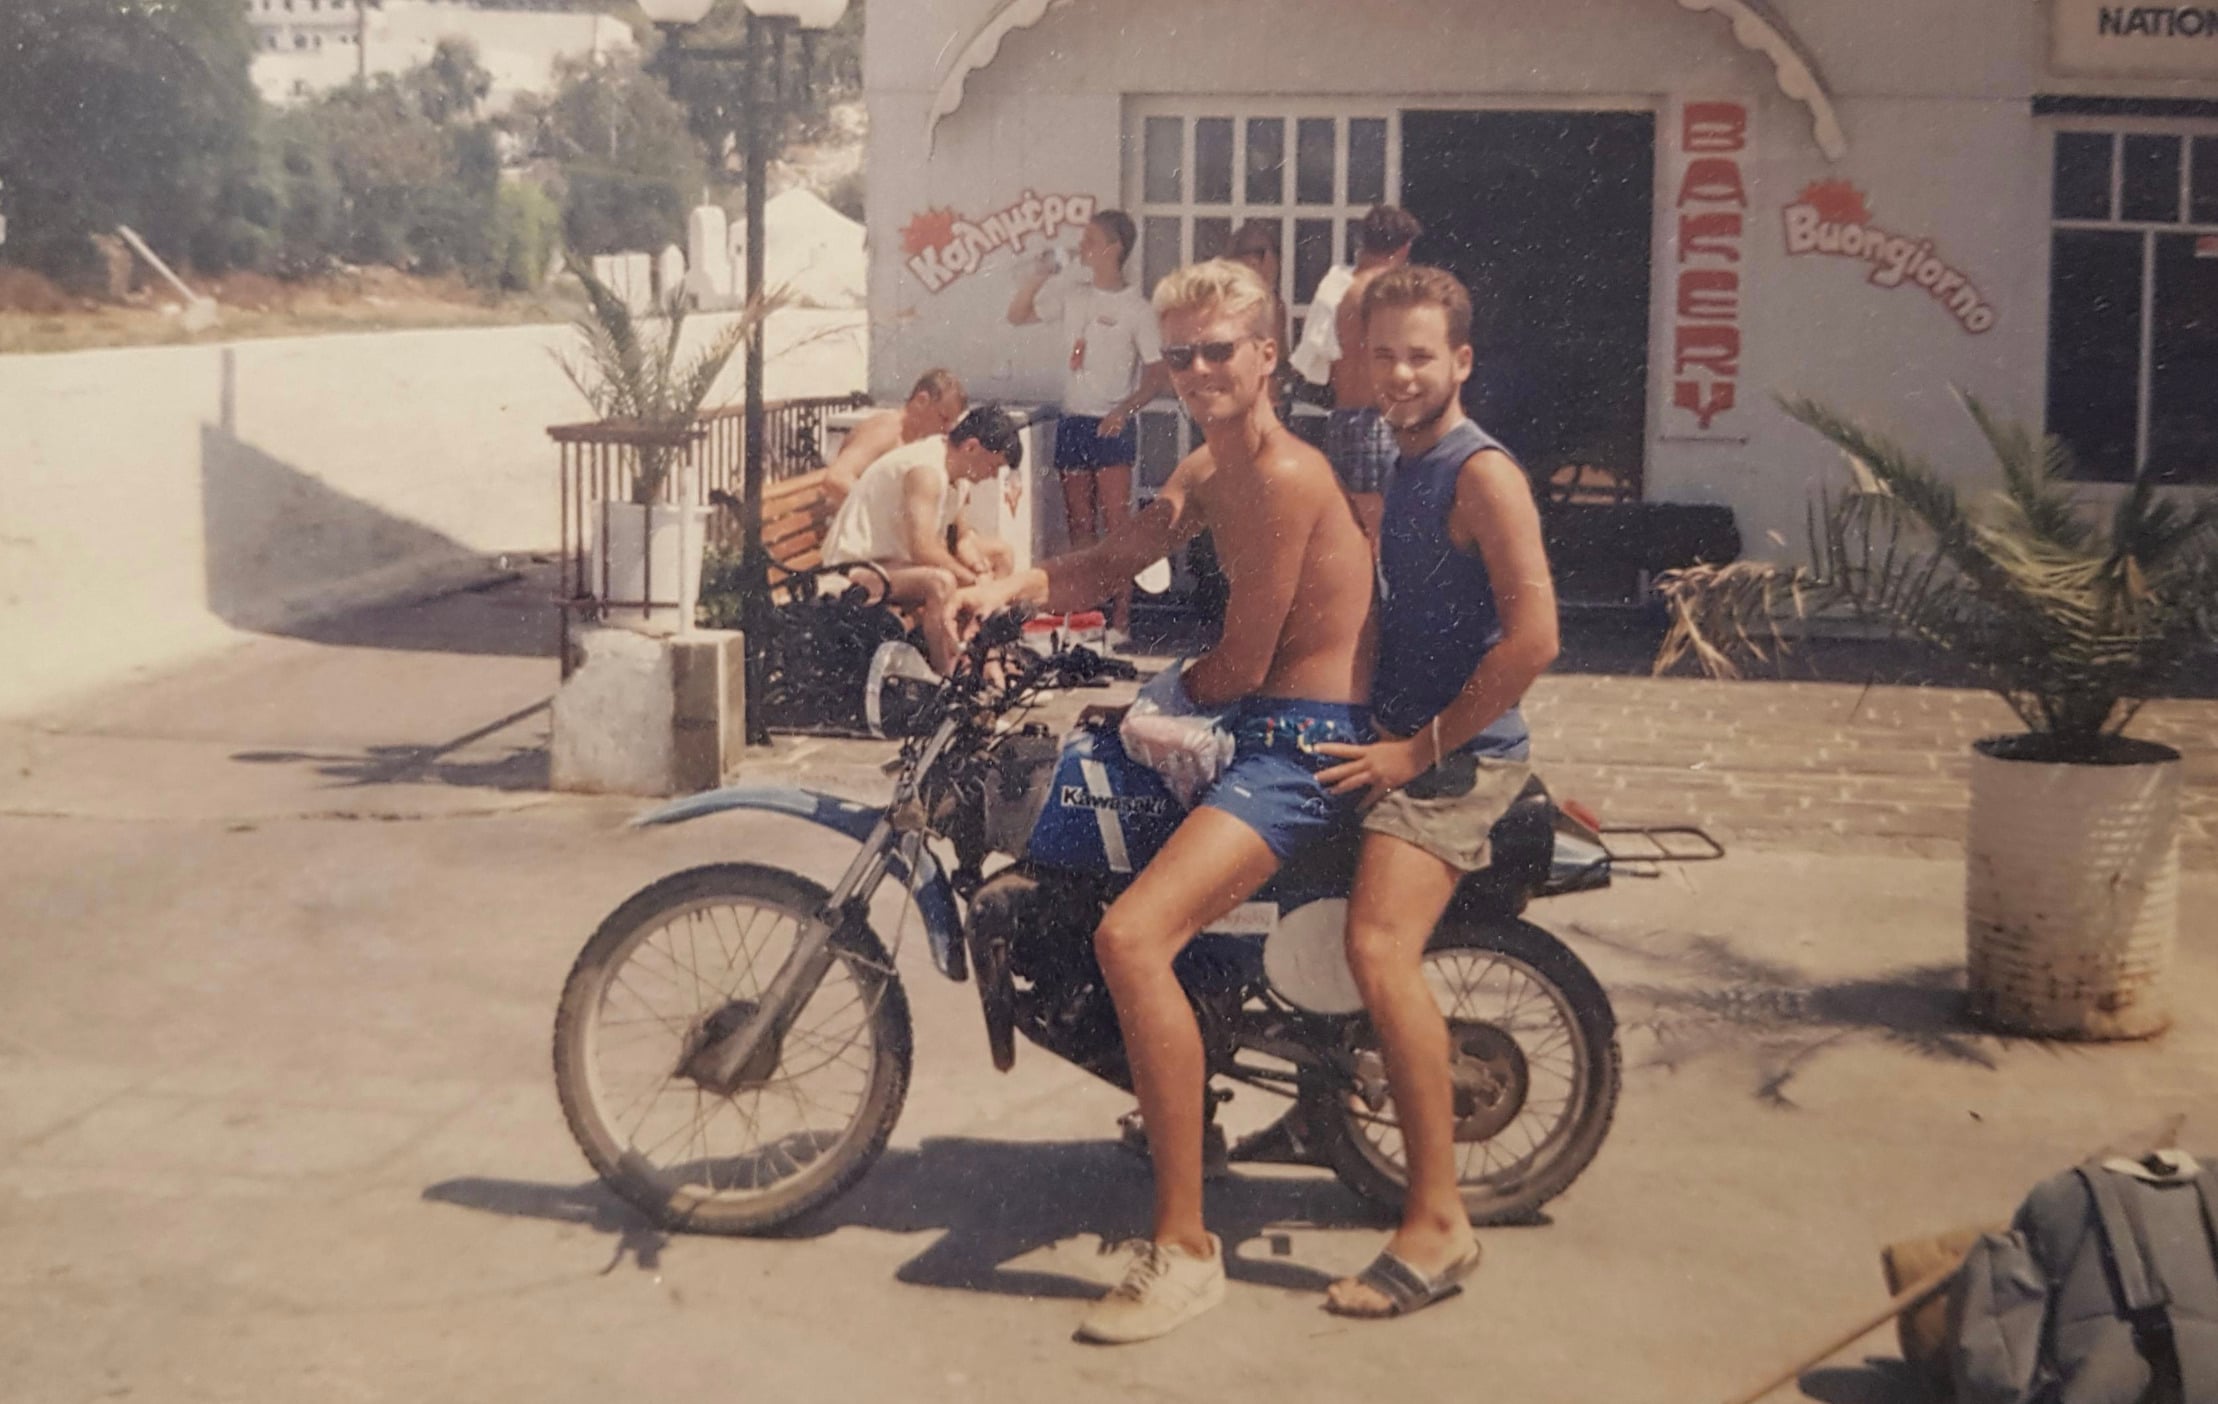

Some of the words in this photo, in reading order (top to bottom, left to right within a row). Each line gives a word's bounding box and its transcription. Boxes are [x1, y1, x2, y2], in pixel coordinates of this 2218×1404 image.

[1674, 102, 1746, 429] BAKERY
[1782, 202, 1995, 334] Buongiorno
[1062, 786, 1167, 815] Kawasaki
